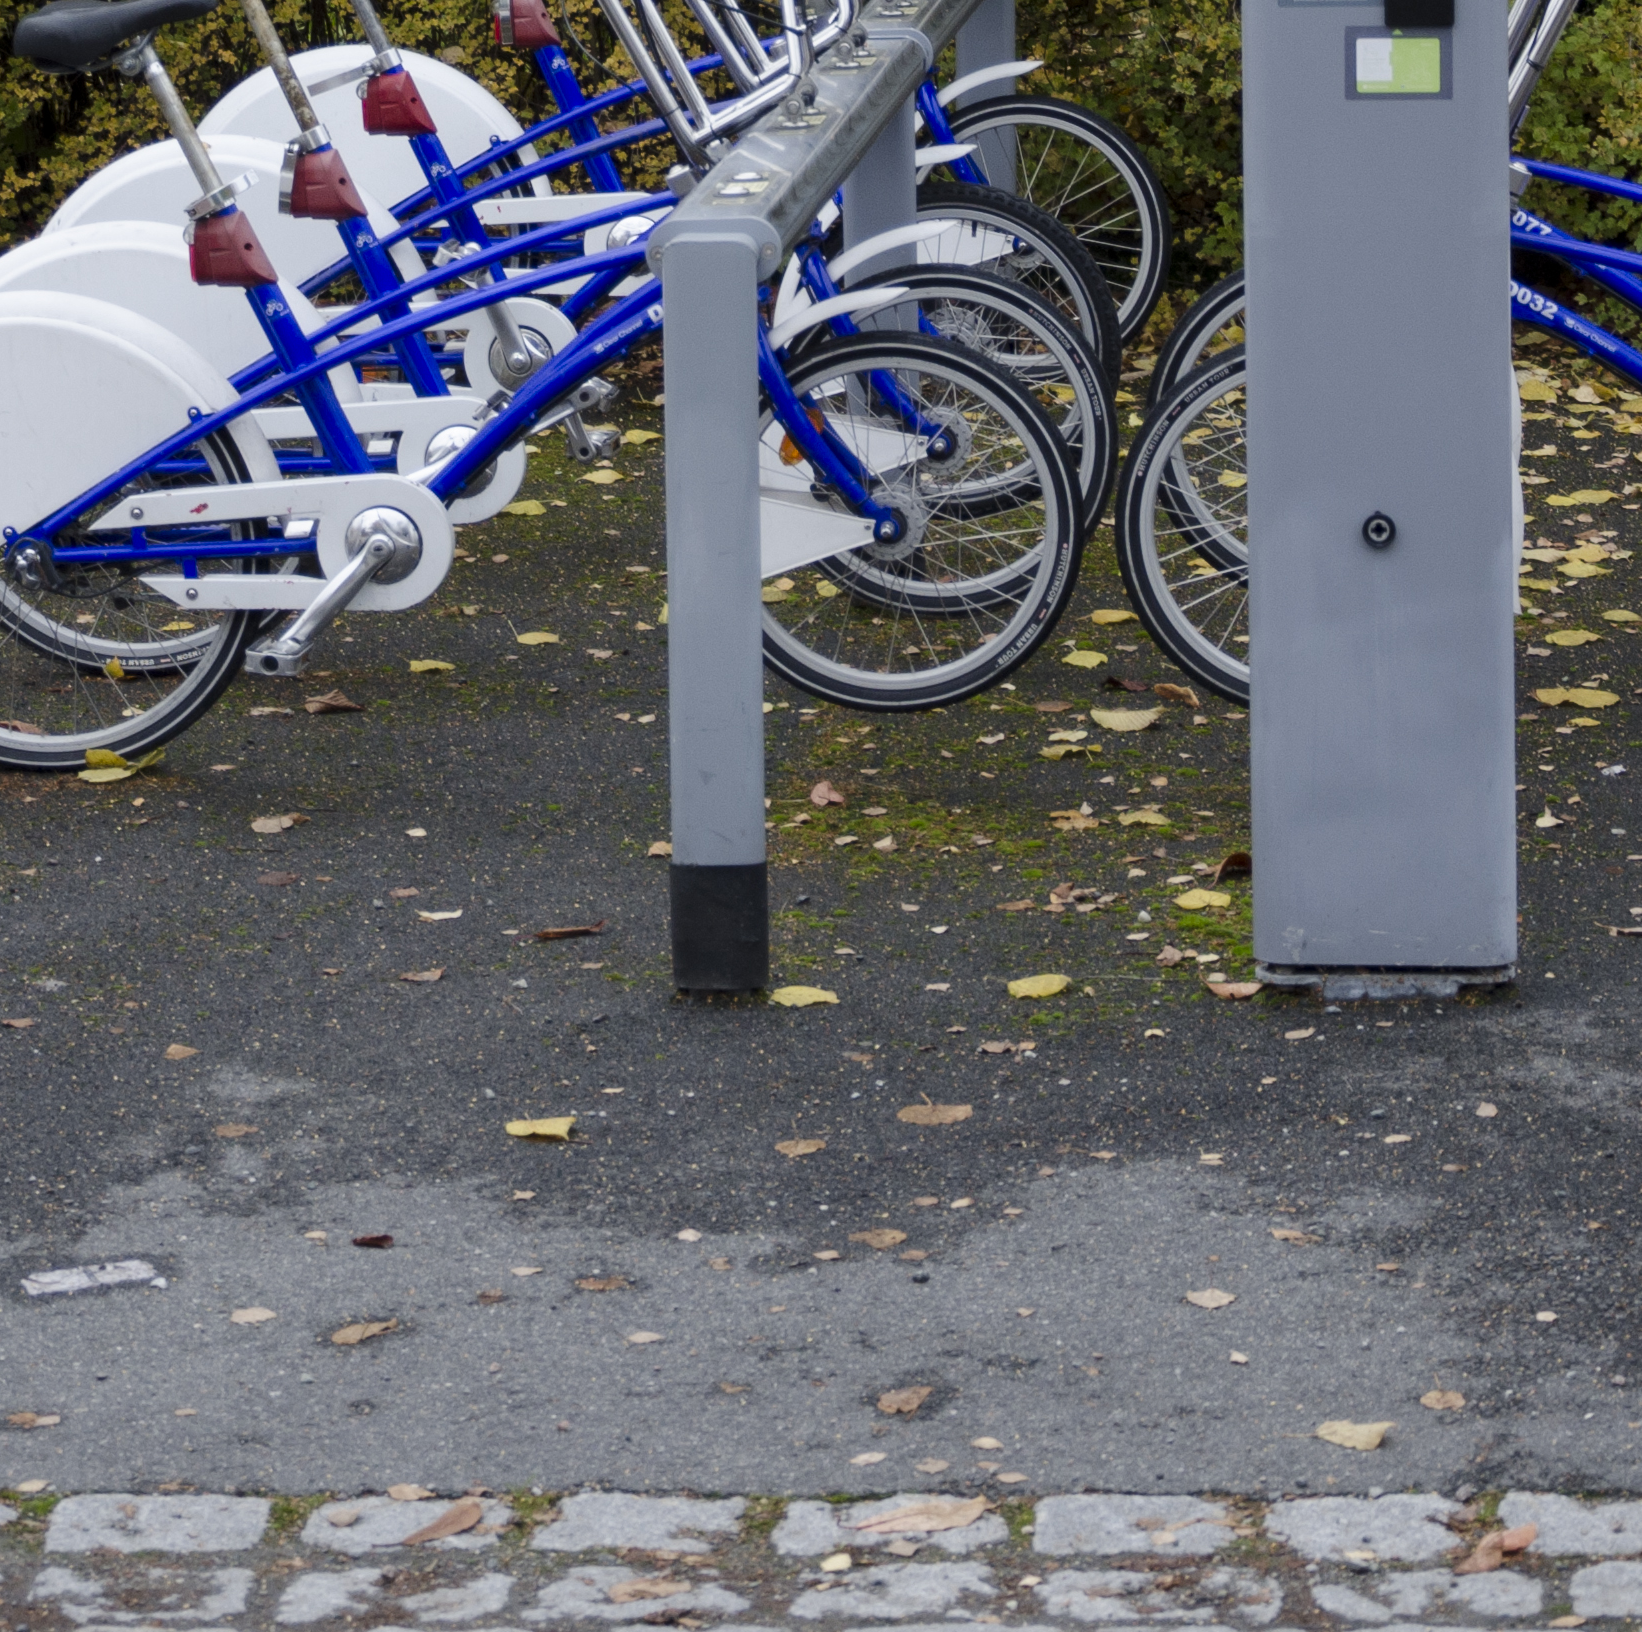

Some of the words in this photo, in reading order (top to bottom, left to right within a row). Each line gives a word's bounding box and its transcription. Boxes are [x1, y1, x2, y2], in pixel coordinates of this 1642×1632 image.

[1184, 382, 1209, 403] URBAN
[1209, 368, 1230, 384] TOUR
[1140, 420, 1170, 471] HUTCHINSON
[1047, 549, 1069, 603] HUTCHINSON
[1017, 623, 1038, 647] URBAN
[998, 647, 1017, 666] TOUR
